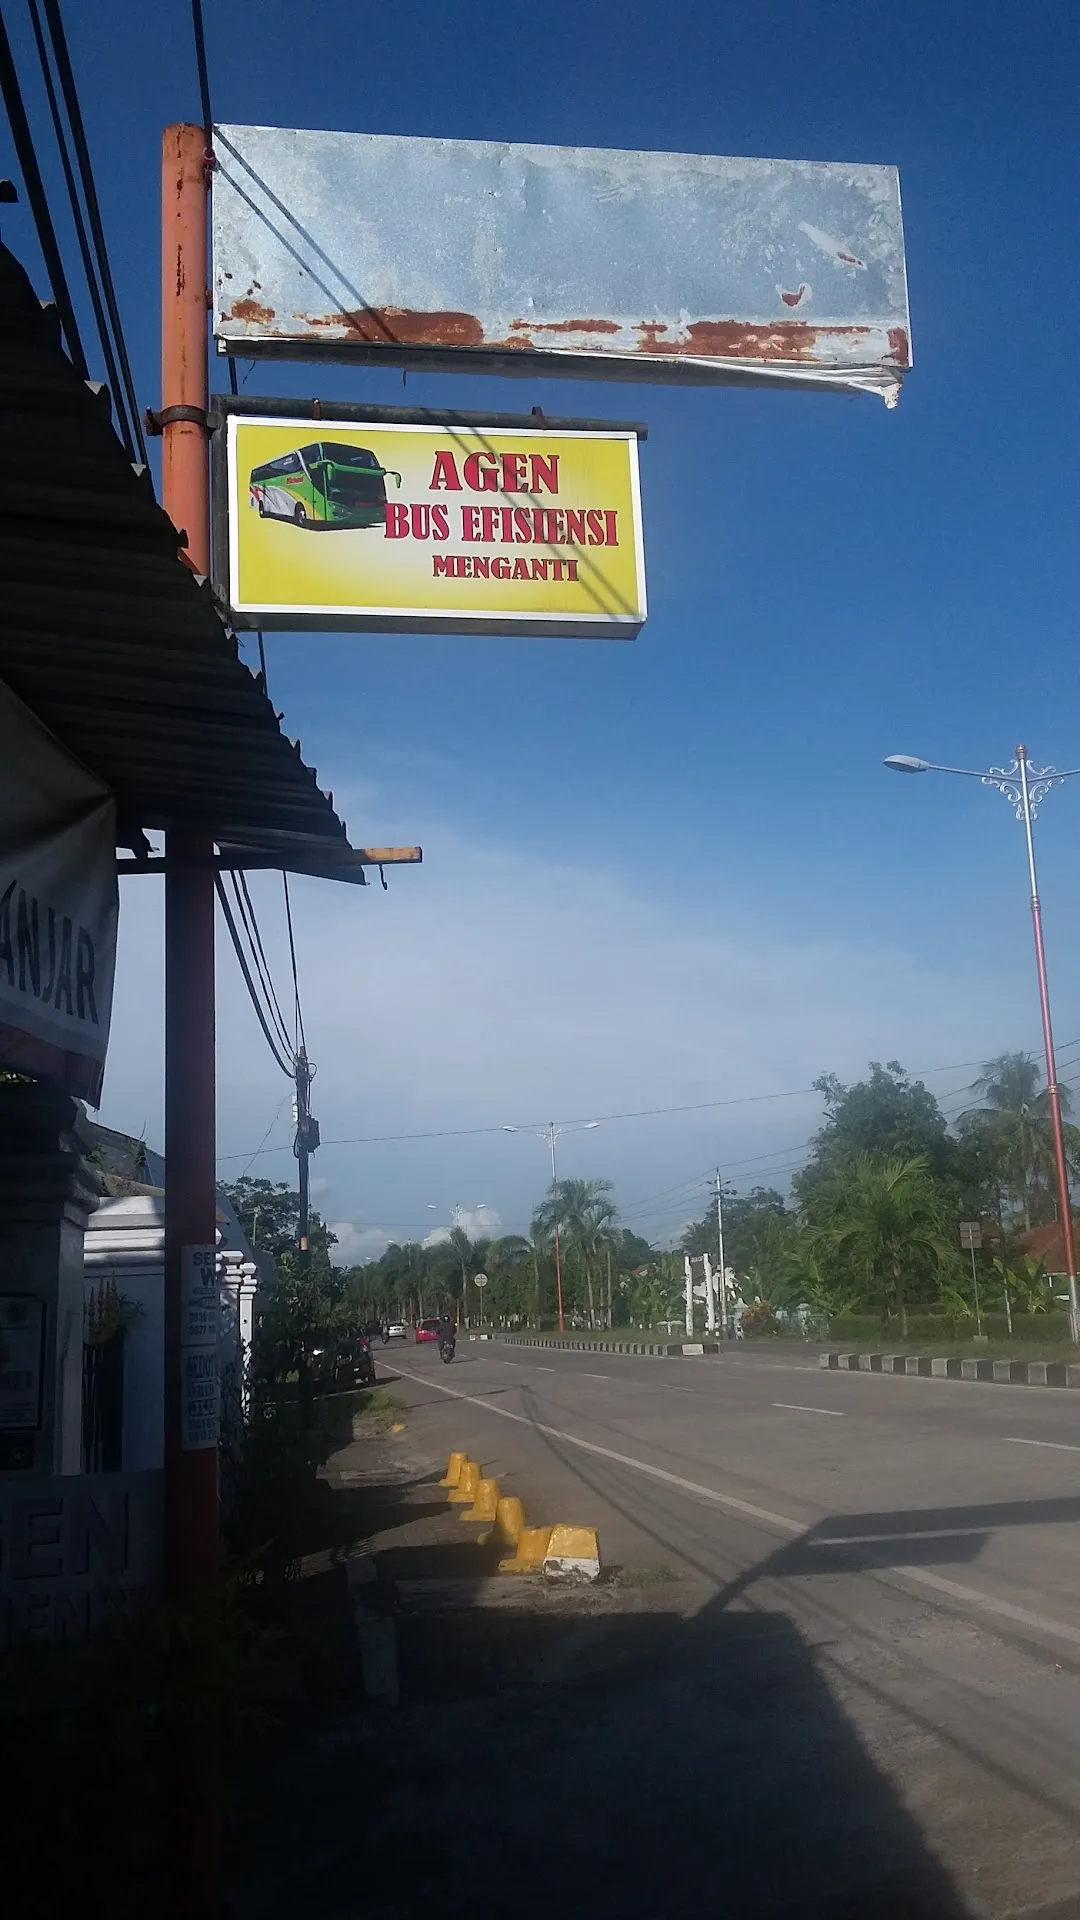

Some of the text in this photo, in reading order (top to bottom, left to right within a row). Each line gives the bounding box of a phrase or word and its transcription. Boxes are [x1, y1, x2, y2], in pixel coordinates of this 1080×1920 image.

[429, 451, 560, 494] AGEN
[384, 503, 619, 547] BUS EFISIENSI
[432, 555, 579, 582] MENGANTI
